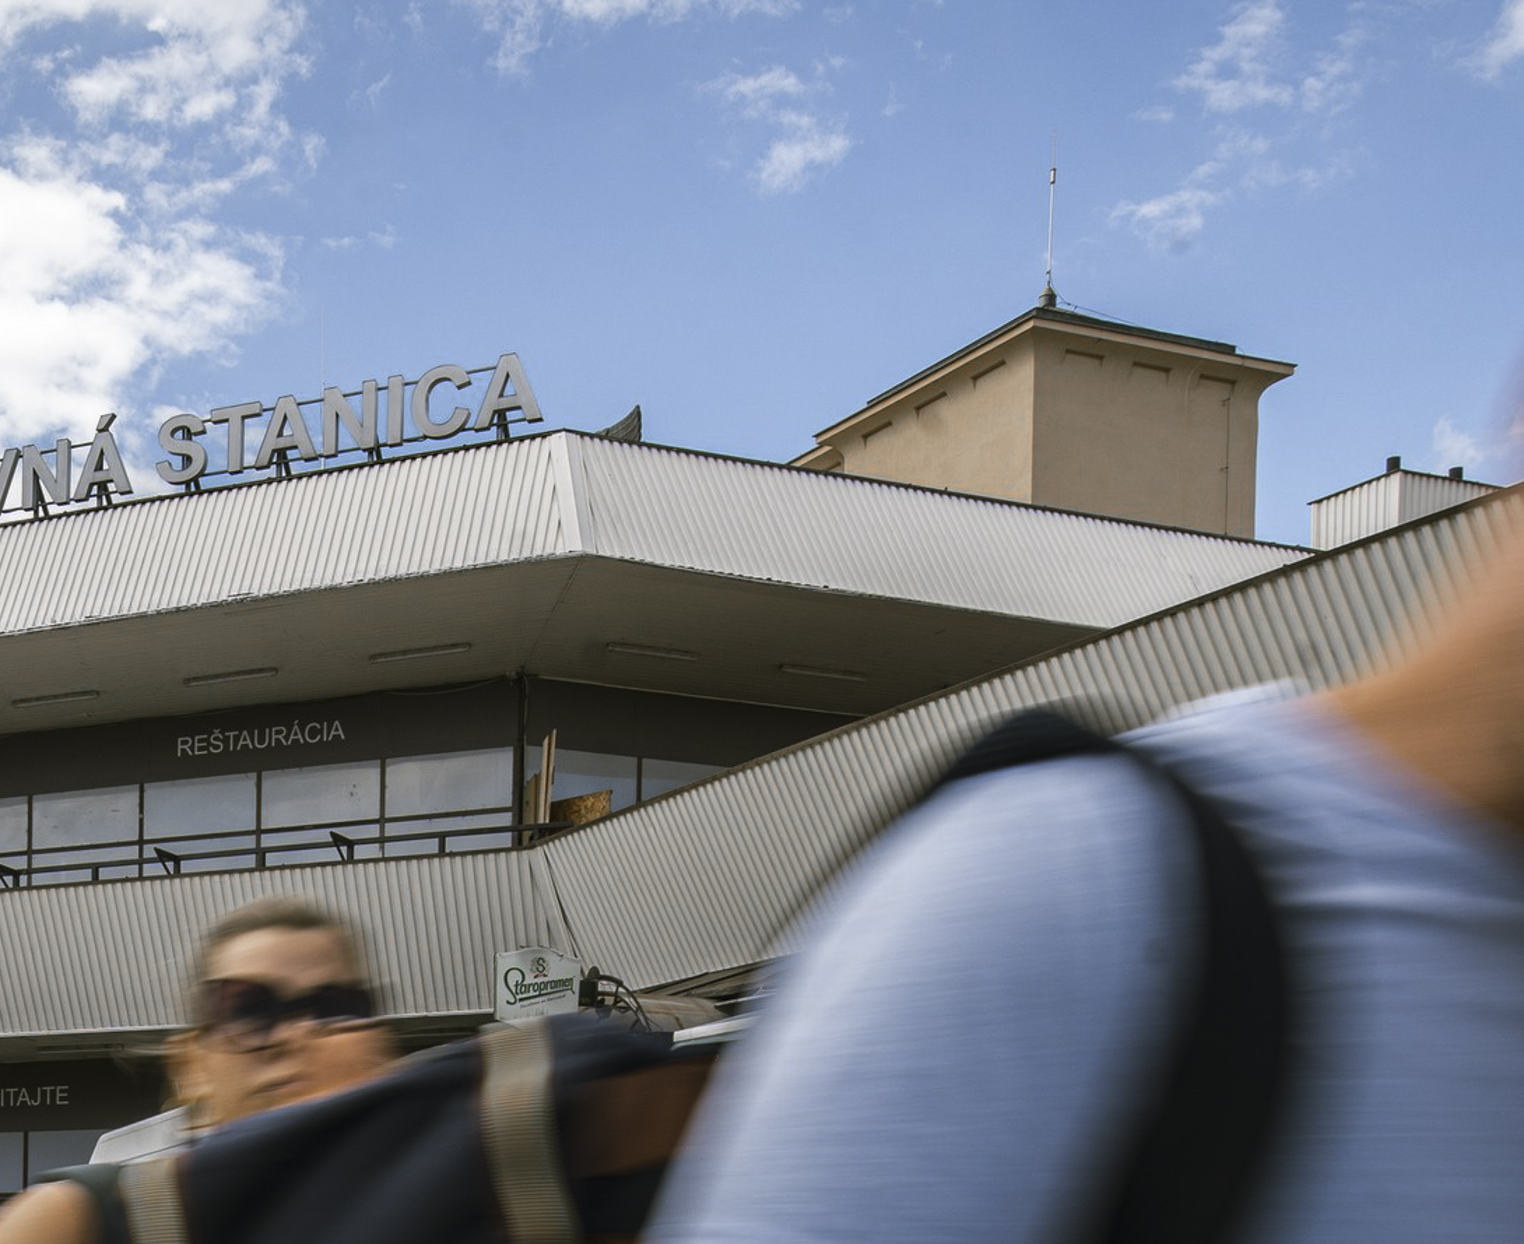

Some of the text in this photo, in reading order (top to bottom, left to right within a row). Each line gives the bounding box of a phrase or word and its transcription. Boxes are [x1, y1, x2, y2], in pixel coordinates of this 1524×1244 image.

[155, 352, 544, 485] STANICA
[177, 720, 346, 757] REŠTAURÁCIA
[503, 966, 576, 1006] Staropramen
